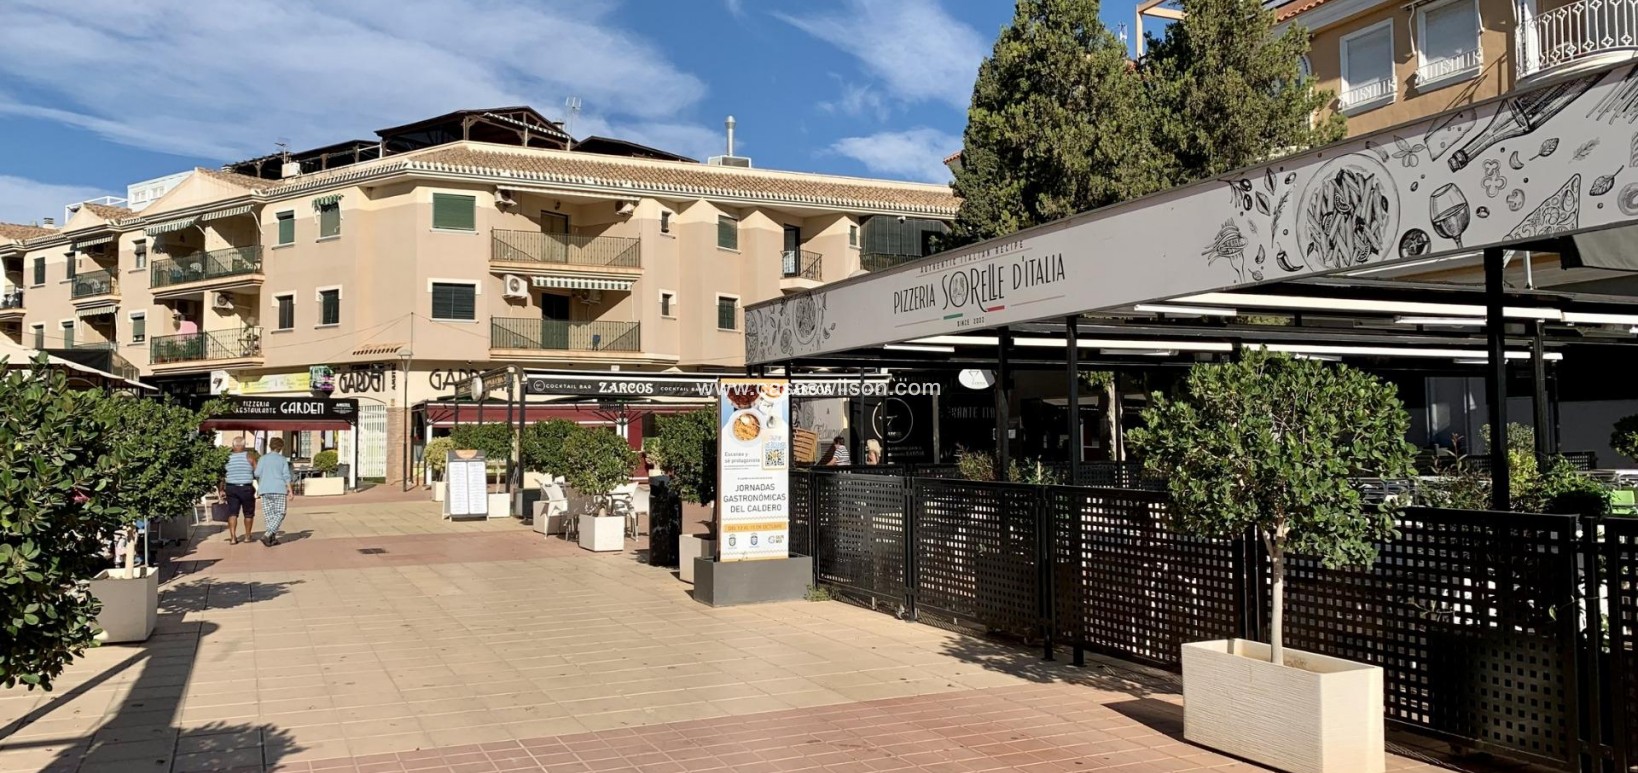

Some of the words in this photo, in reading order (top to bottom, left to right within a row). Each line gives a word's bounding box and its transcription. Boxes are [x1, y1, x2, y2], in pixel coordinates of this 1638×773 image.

[920, 257, 956, 273] AUTHENTIC
[961, 249, 990, 263] ITALIAN
[995, 240, 1023, 254] RECIPE
[893, 283, 936, 315] PIZZERIA
[1012, 252, 1066, 291] D'ITALIA
[339, 370, 386, 393] GARDEN
[598, 381, 654, 394] ZARCOS
[280, 401, 324, 415] GARDEN
[735, 483, 775, 492] JORNADAS
[723, 493, 786, 503] GASTRONÓMICAS
[730, 505, 745, 513] DEL
[747, 504, 782, 513] CALDERO
